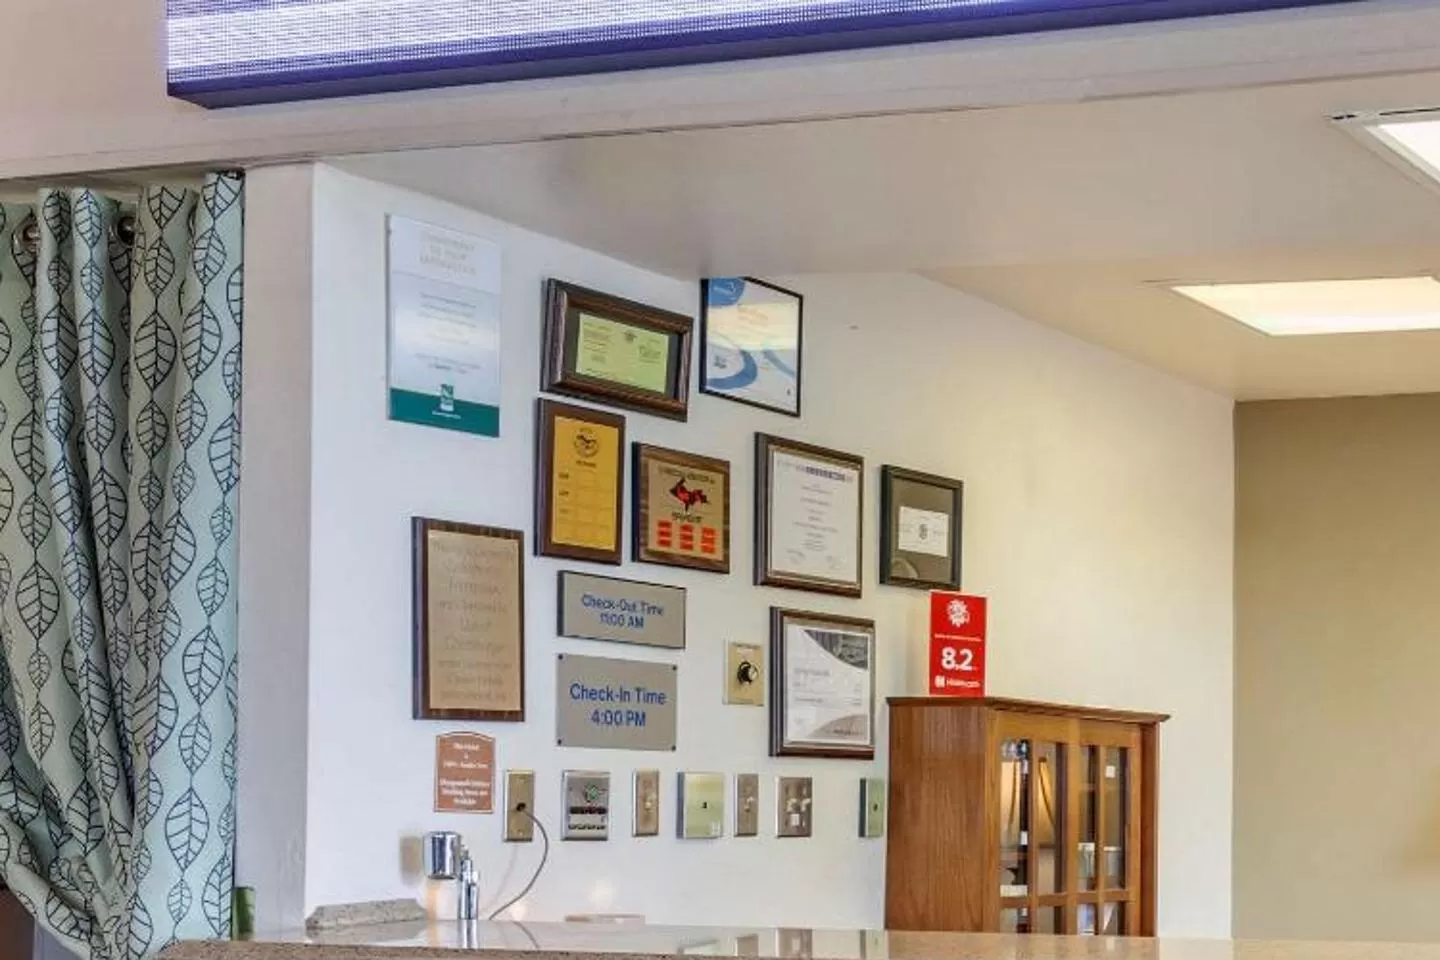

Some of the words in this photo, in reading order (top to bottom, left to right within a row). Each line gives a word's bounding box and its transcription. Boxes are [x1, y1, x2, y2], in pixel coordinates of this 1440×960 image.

[581, 593, 637, 613] Check-Out
[641, 602, 665, 616] Time
[627, 617, 645, 629] AM
[941, 646, 974, 672] 8.2
[569, 683, 631, 703] Check-In
[635, 687, 668, 706] Time
[590, 709, 623, 727] 4:00
[626, 711, 647, 728] PM
